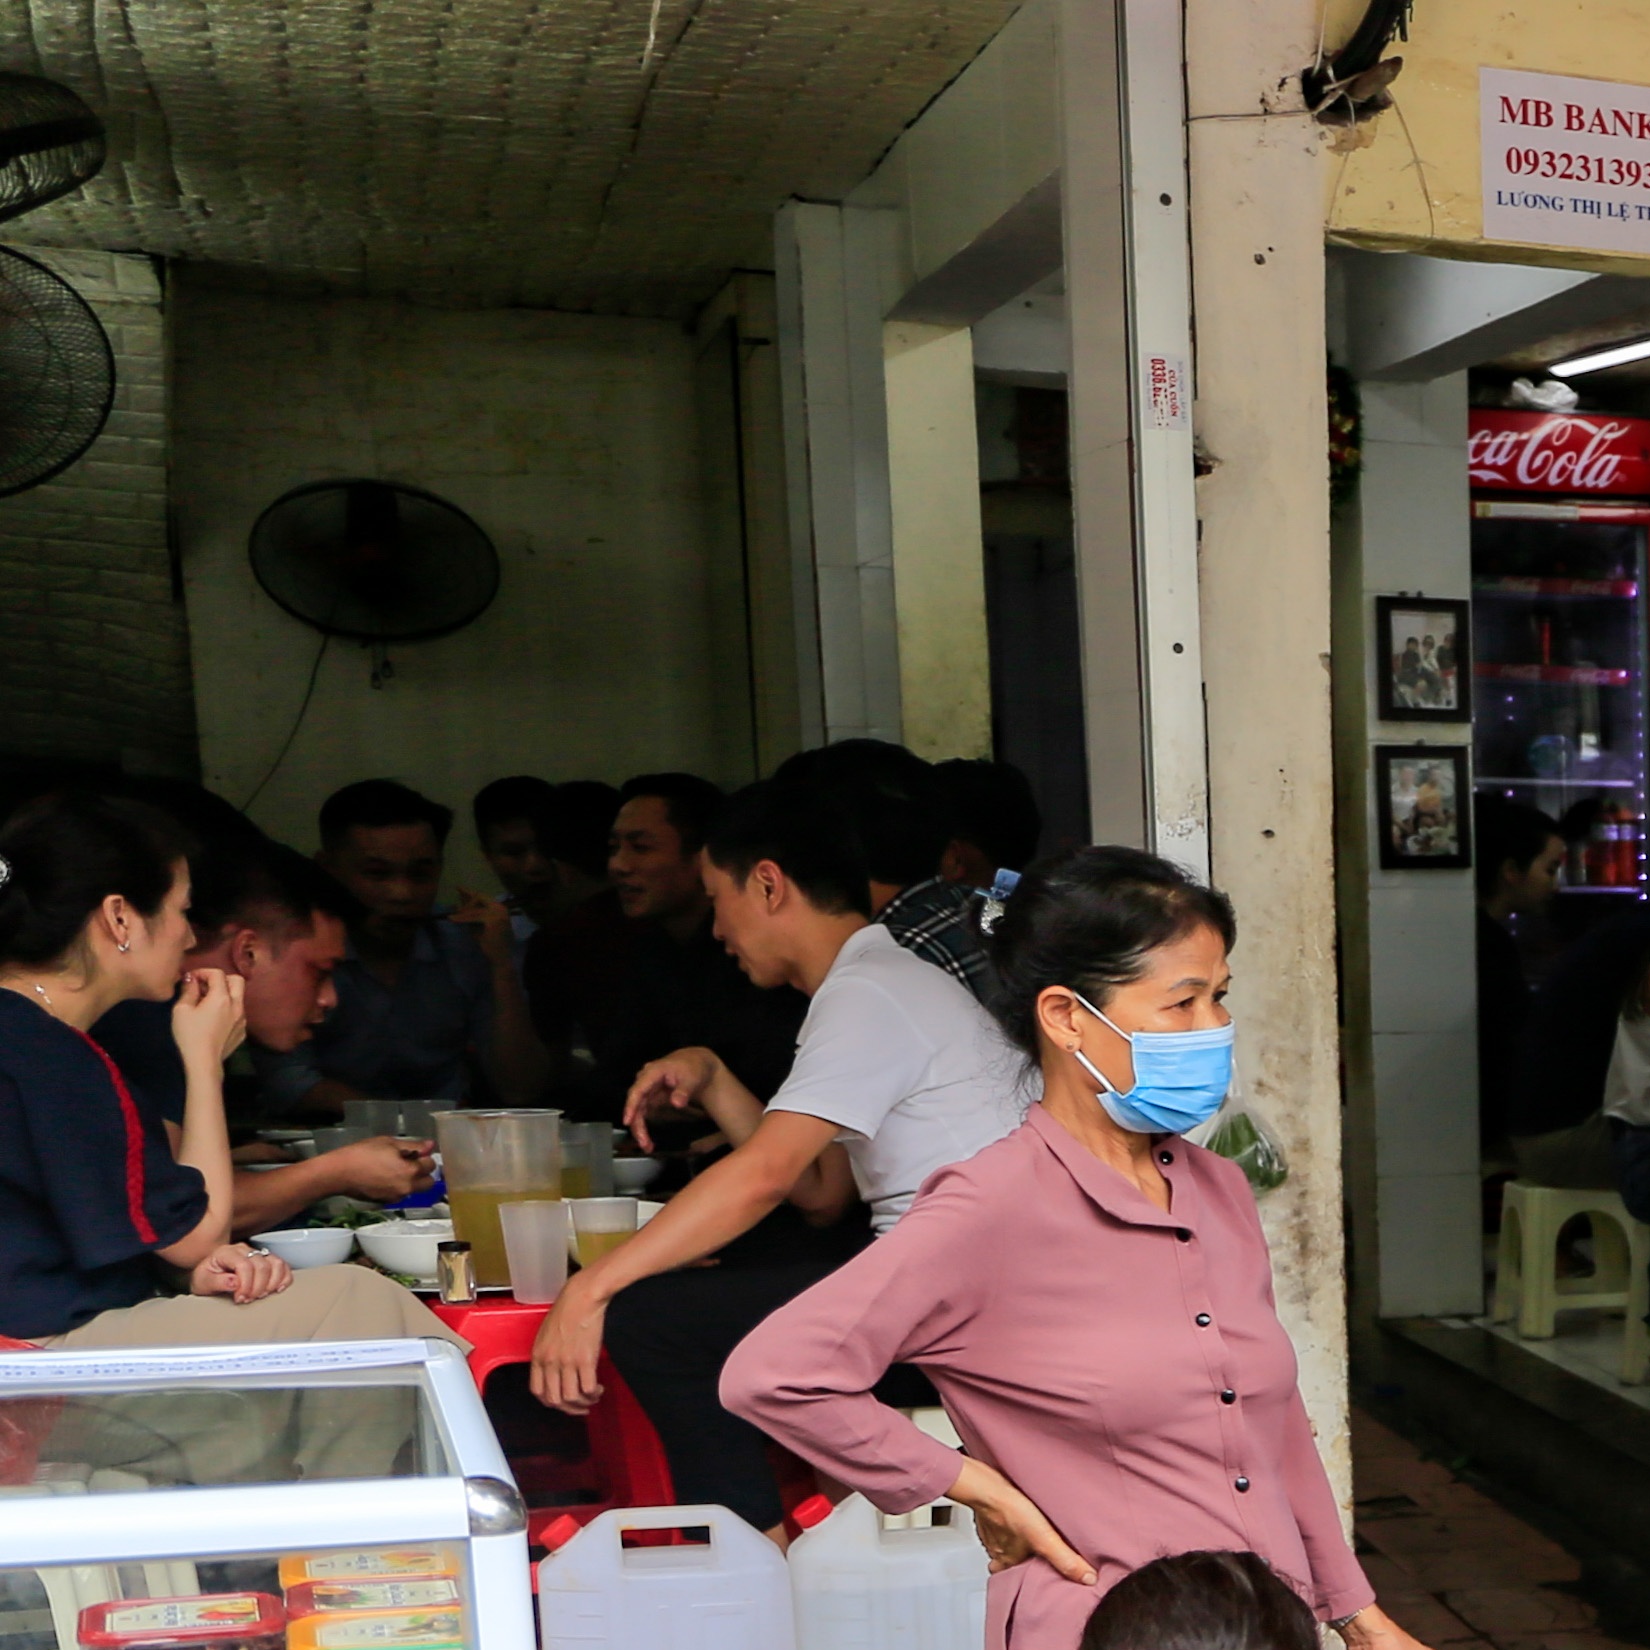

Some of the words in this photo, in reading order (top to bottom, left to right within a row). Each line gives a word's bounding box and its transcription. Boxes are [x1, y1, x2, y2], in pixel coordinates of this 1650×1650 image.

[1499, 95, 1554, 128] MB
[1569, 197, 1601, 219] THỊ
[1607, 201, 1630, 222] LỆ
